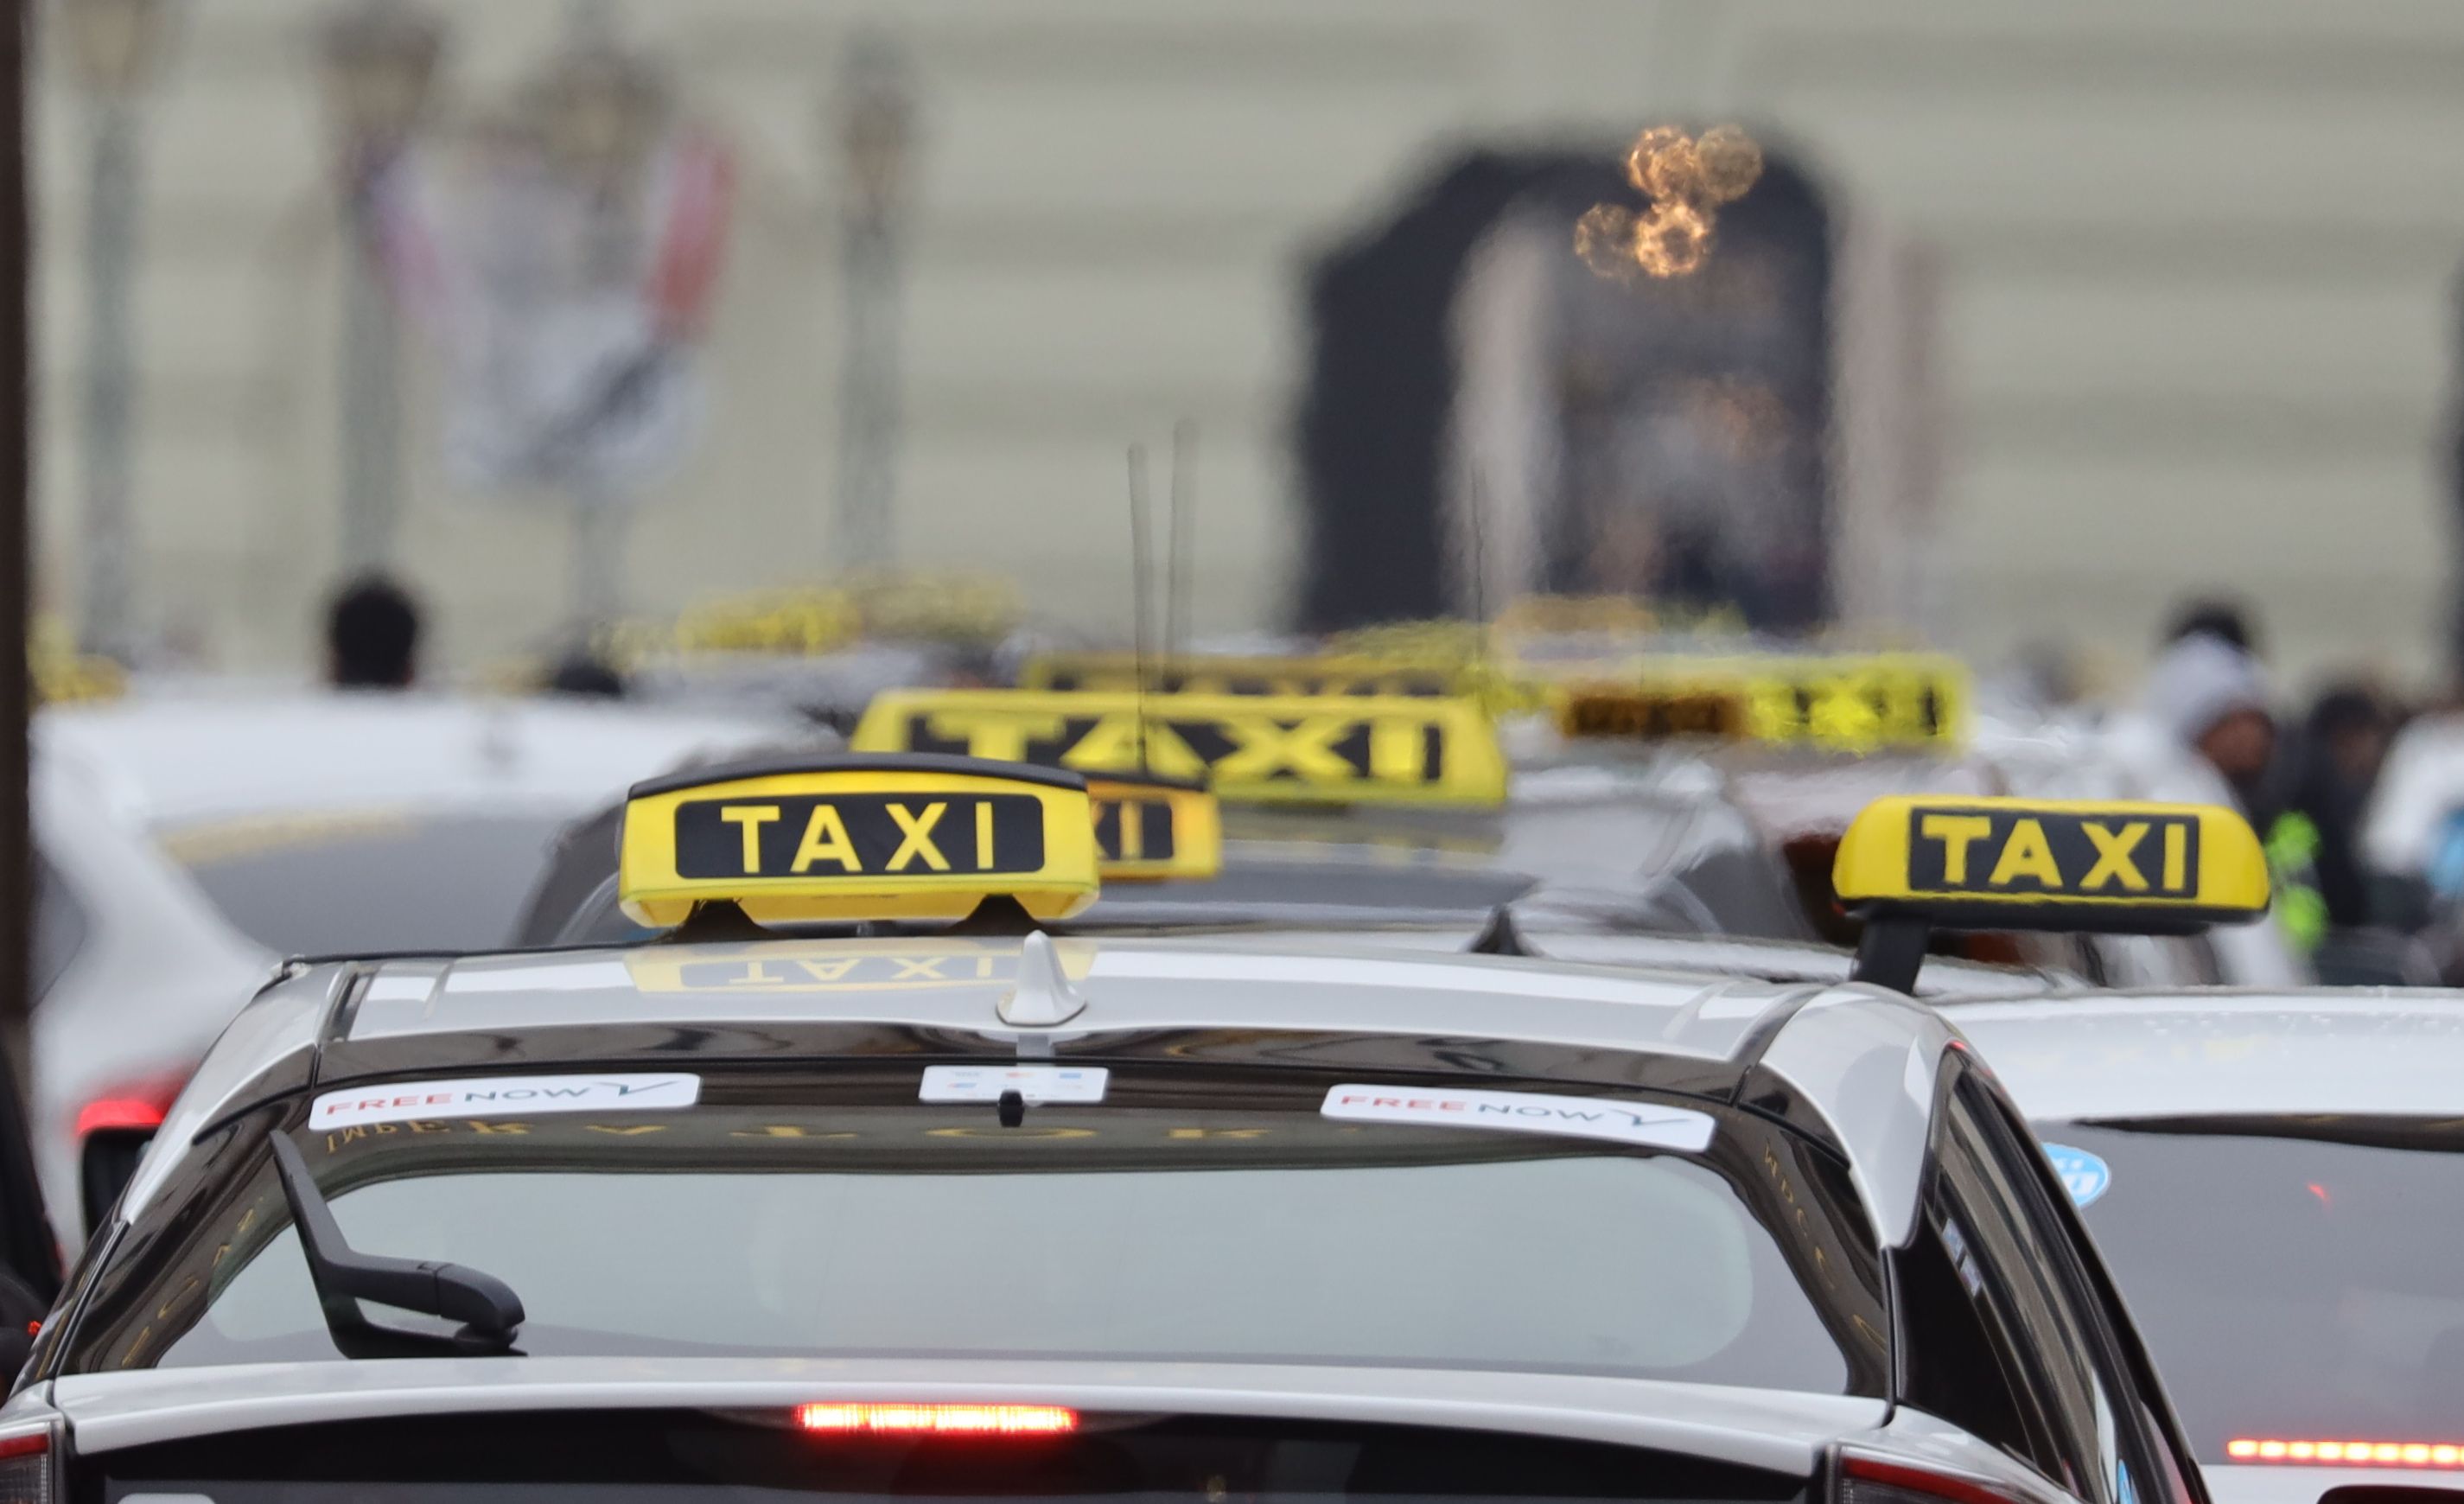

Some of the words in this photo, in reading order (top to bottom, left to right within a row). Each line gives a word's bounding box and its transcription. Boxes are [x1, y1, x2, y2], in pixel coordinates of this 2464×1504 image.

[924, 712, 1425, 780] TAXI
[721, 801, 994, 874] TAXI
[1921, 814, 2187, 892] TAXI
[326, 1093, 454, 1116] FREE
[464, 1087, 592, 1103] NOW
[1340, 1095, 1467, 1113] FREE
[1477, 1103, 1605, 1123] NOW
